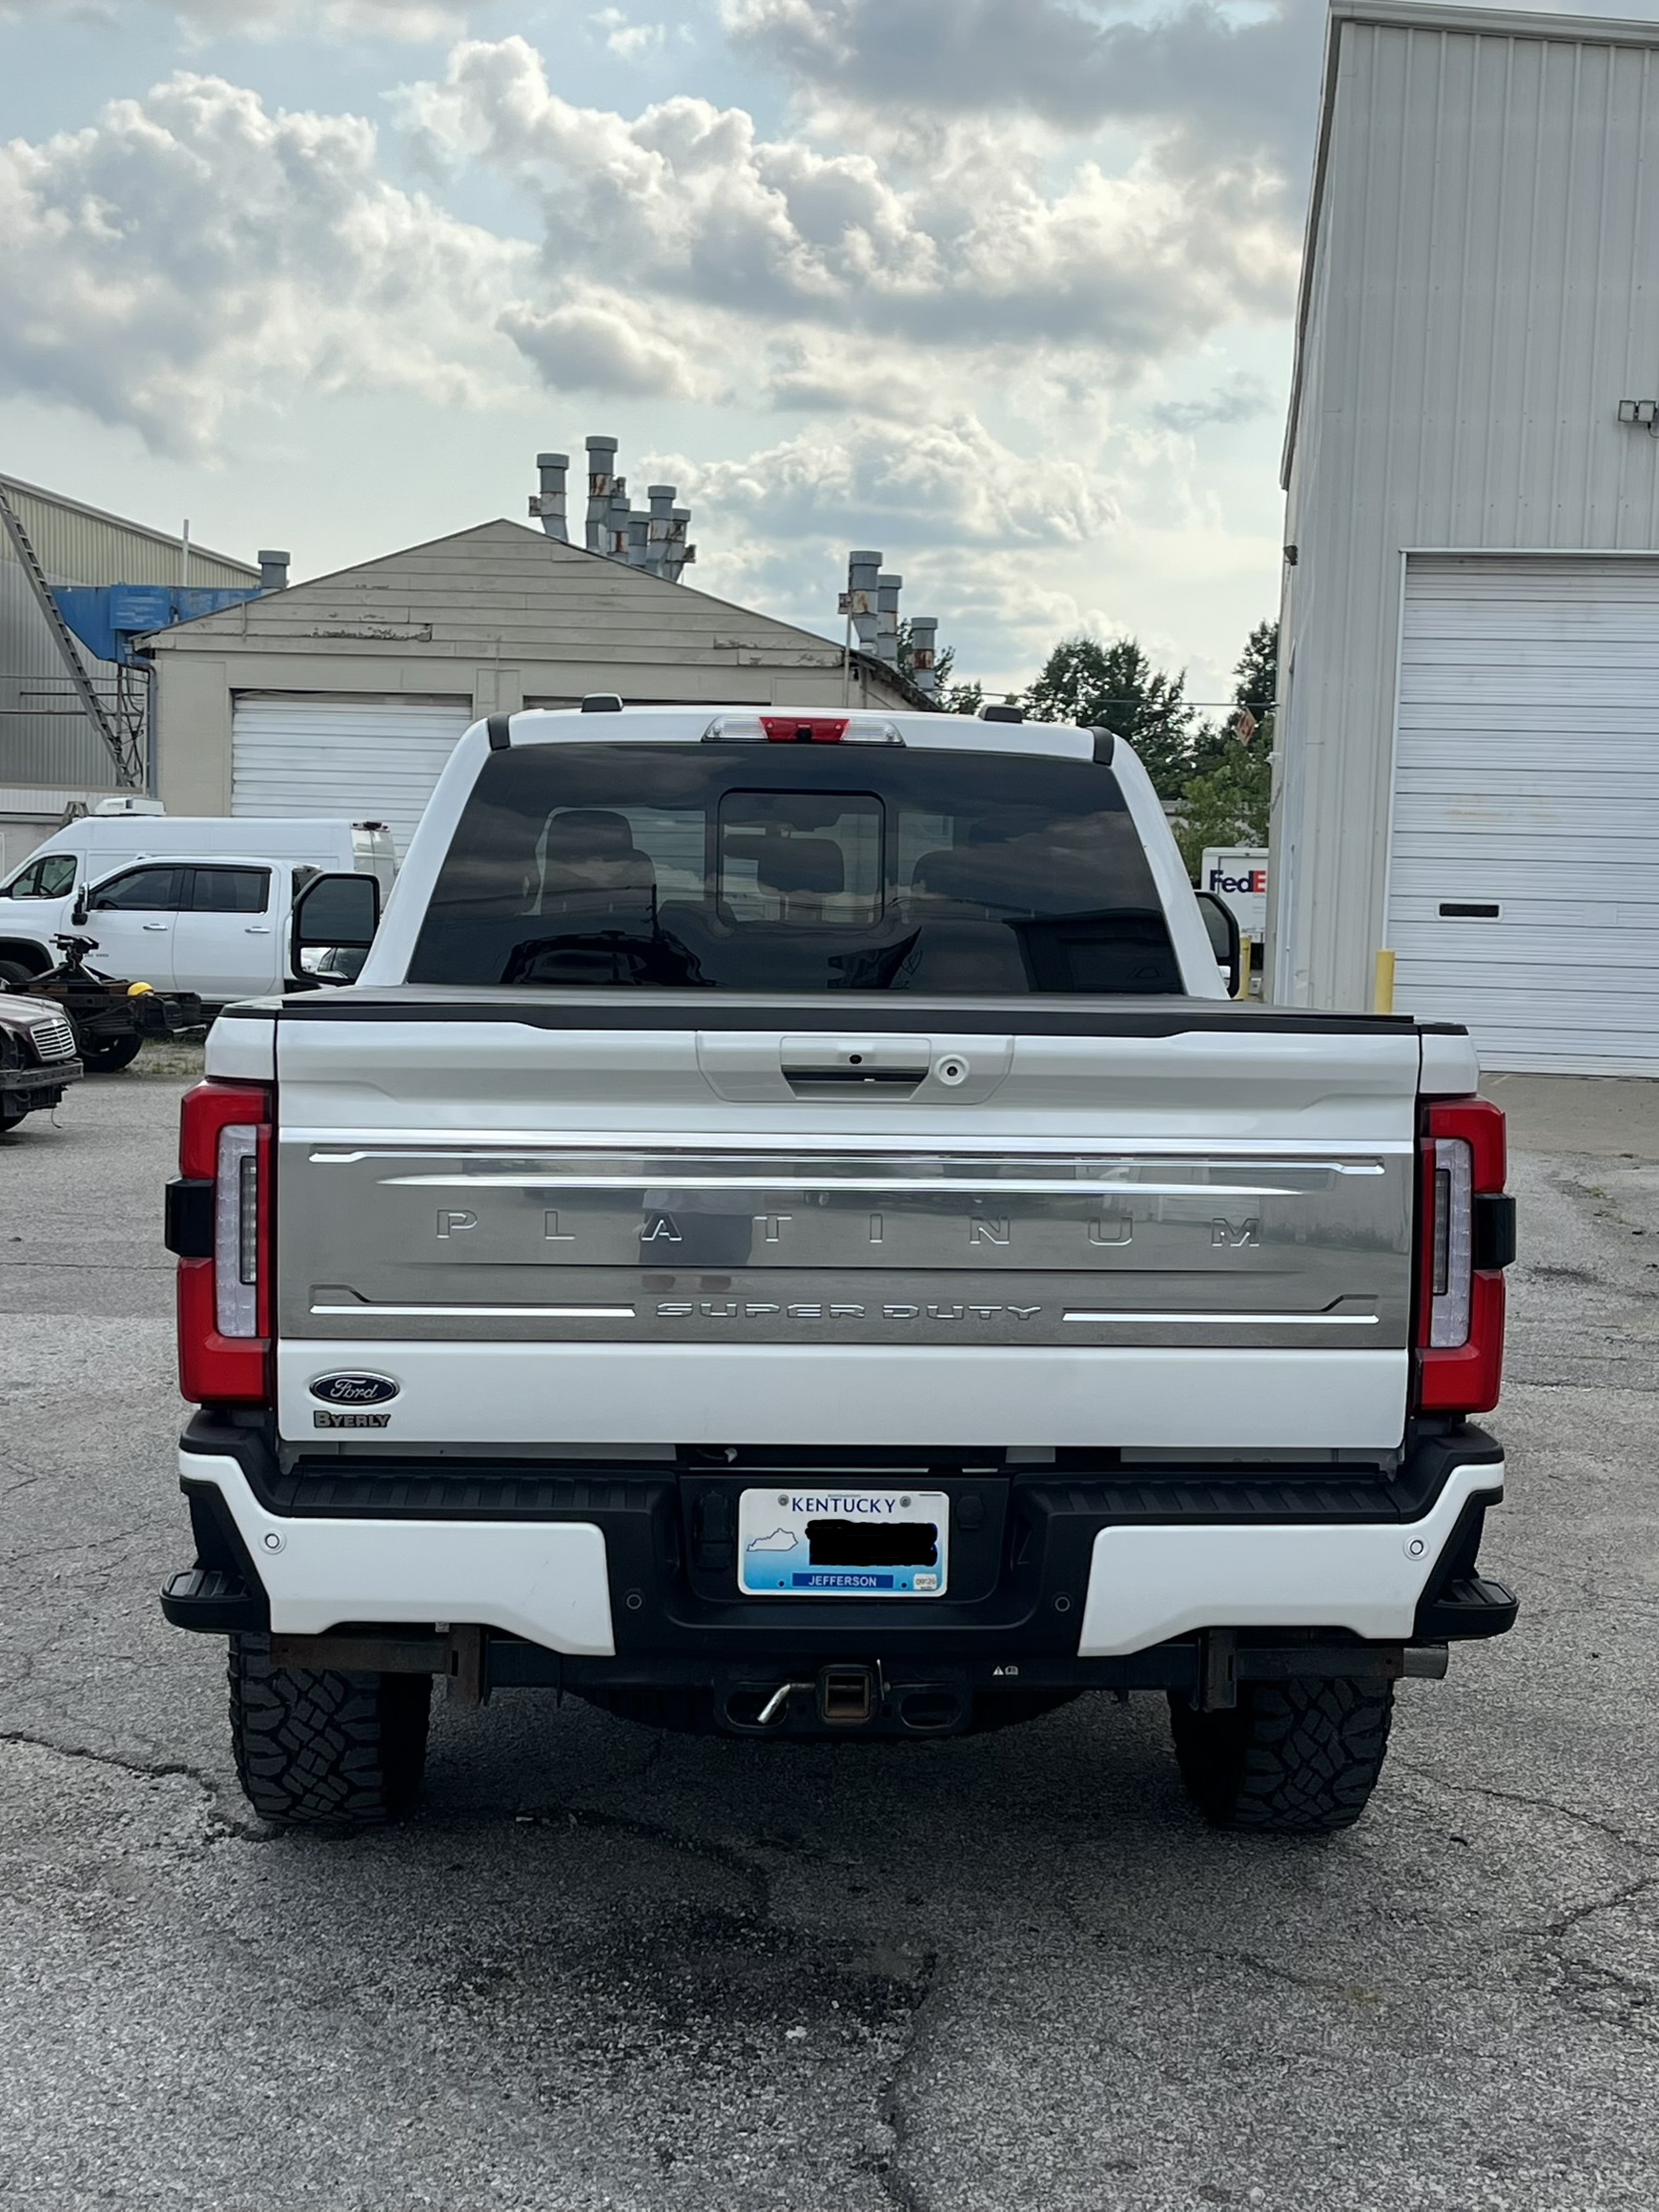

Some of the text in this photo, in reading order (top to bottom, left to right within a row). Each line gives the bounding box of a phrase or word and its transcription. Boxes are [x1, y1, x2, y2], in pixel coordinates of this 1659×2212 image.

[1209, 870, 1266, 893] FedE
[436, 1209, 1260, 1247] PLATINUM
[656, 1302, 1041, 1321] SUPER DUTY
[330, 1378, 379, 1399] Ford
[313, 1410, 392, 1428] BYERLY
[791, 1497, 896, 1514] KENTUCKY
[808, 1574, 877, 1587] JEFFERSON
